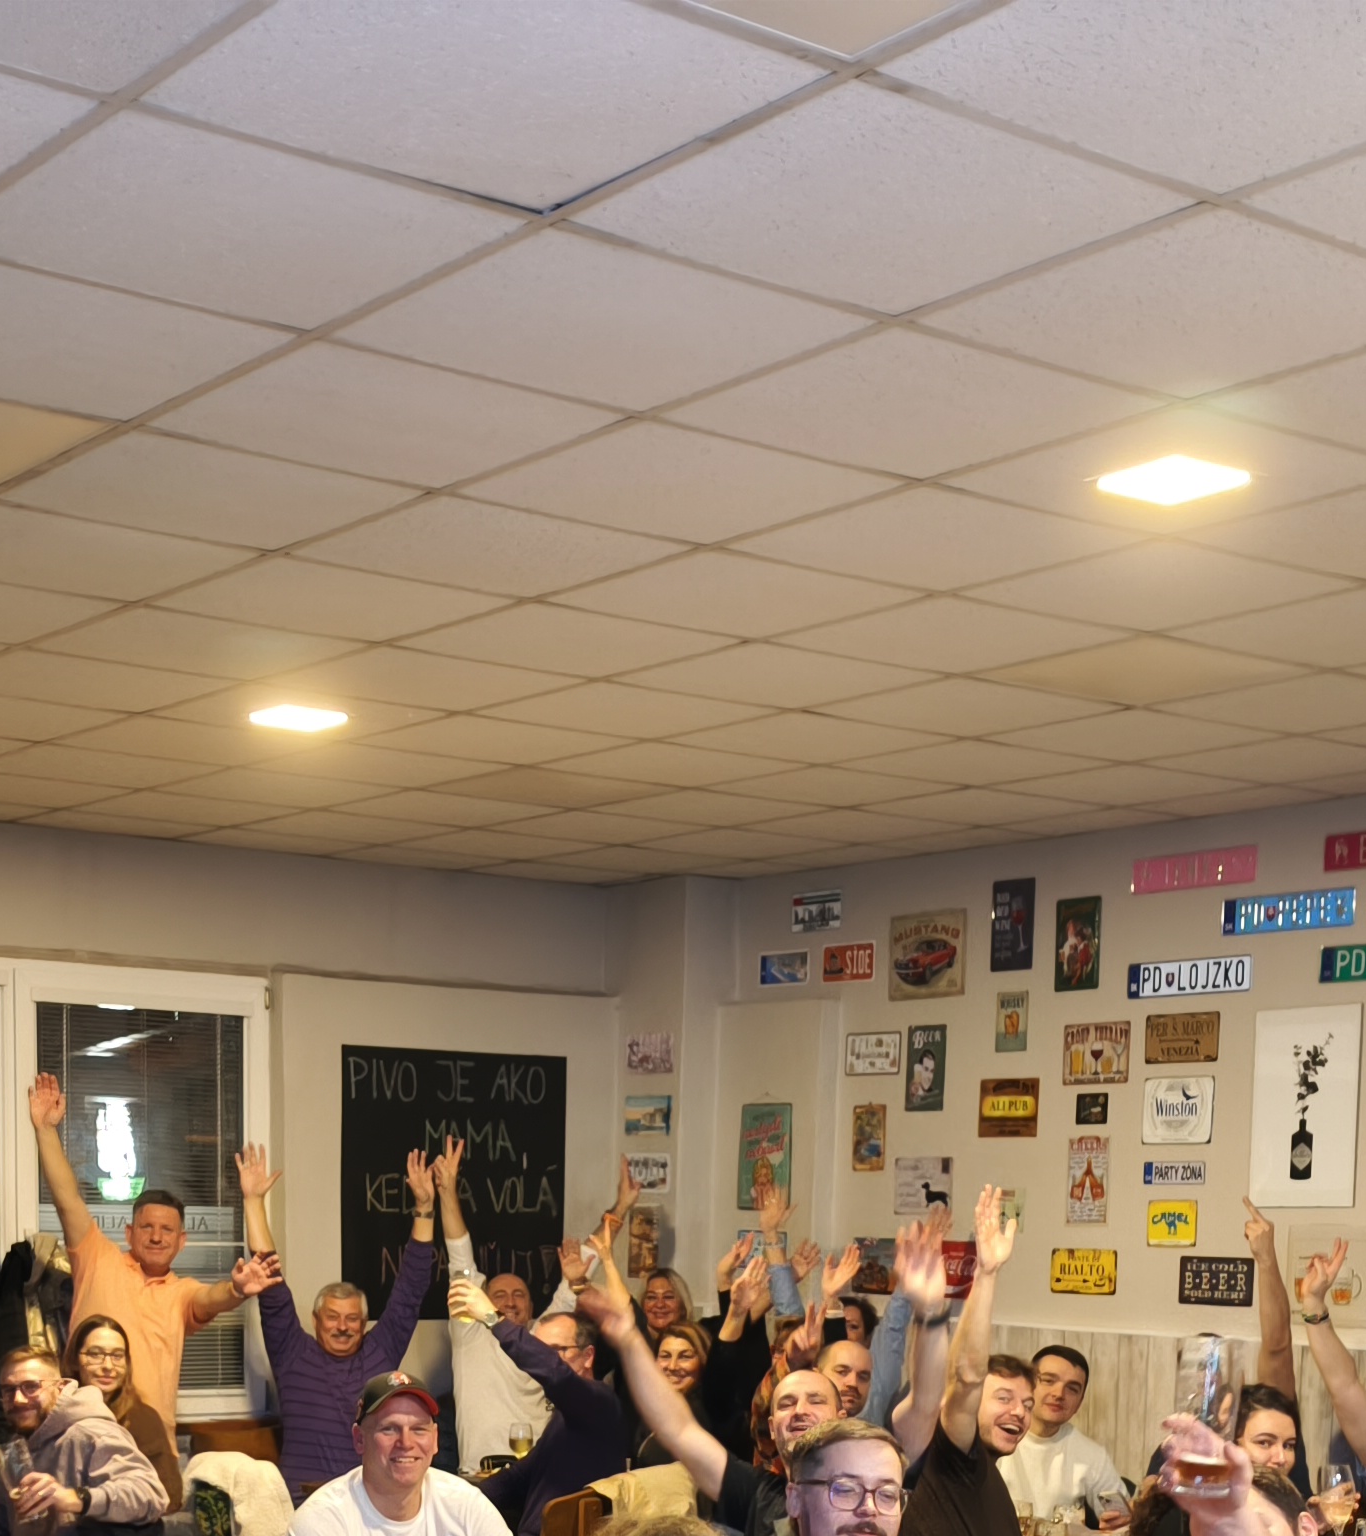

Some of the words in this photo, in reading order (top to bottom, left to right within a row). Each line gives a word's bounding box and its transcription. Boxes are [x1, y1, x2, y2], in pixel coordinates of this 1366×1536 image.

[893, 923, 961, 945] MUSTANG
[1335, 949, 1365, 978] PD
[1142, 966, 1162, 993] PD
[1178, 959, 1245, 992] LOJZKO
[1182, 1020, 1214, 1035] MARCO
[348, 1056, 417, 1101] PIVO
[436, 1060, 475, 1102] JE
[491, 1063, 546, 1104] AKO
[990, 1100, 1006, 1111] ALI
[1008, 1099, 1028, 1111] PUB
[1155, 1097, 1197, 1117] Winston
[1152, 1211, 1189, 1225] CAMEL
[1060, 1263, 1105, 1277] RIALTO
[1212, 1262, 1247, 1272] COLD
